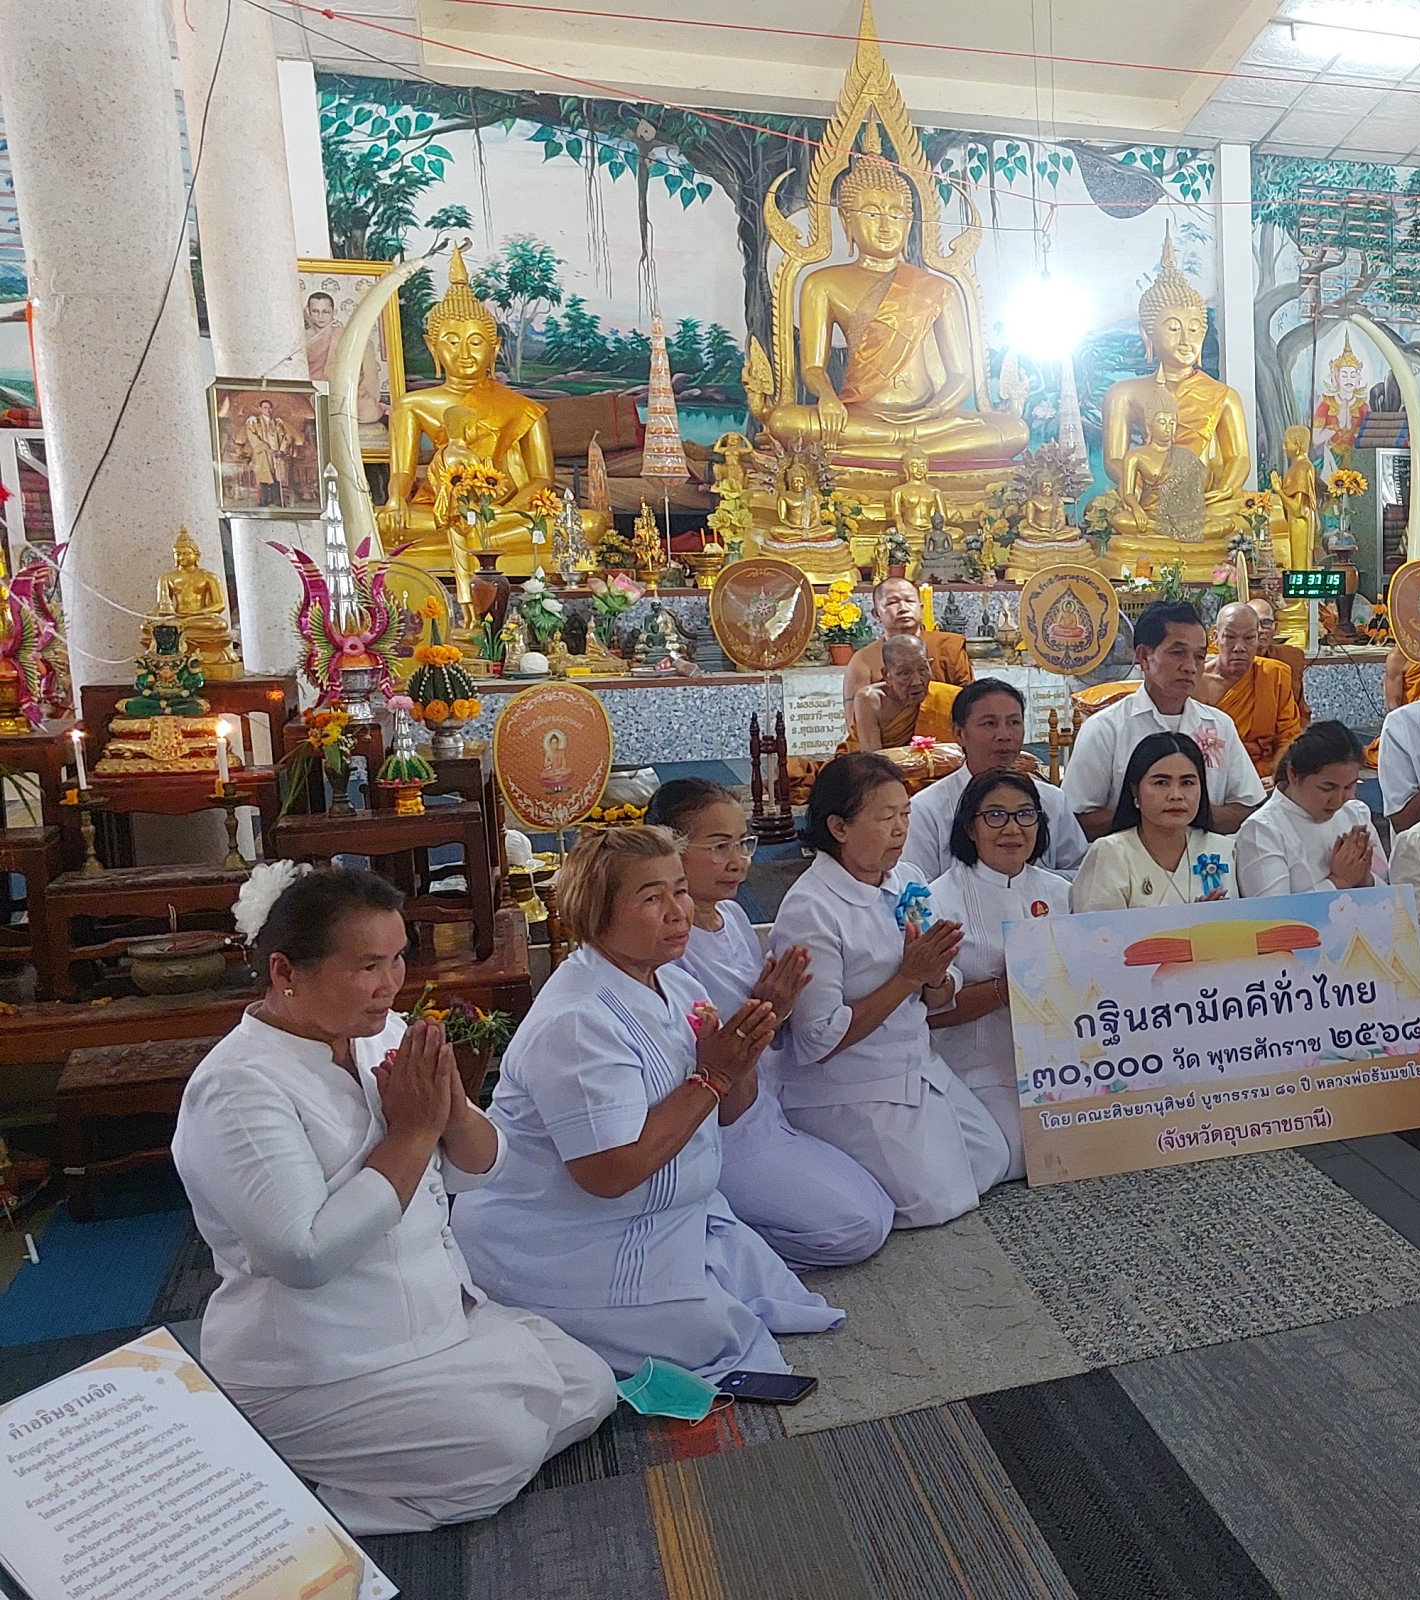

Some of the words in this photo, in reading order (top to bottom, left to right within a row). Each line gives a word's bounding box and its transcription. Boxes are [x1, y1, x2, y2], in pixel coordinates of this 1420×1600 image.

[1074, 970, 1377, 1045] กฐินสามัคคีทั่วไทย
[1032, 1052, 1163, 1089] ๓๐,๐๐๐
[1172, 1047, 1200, 1070] วัด
[1206, 1034, 1321, 1075] พุทธศักราช
[1041, 1111, 1071, 1130] โดย
[1077, 1089, 1195, 1124] คณะศิษยานุศิษย์
[1200, 1084, 1271, 1113] บูชาธรรม
[1275, 1081, 1296, 1097] ๘๑
[1301, 1075, 1311, 1093] ปี
[1156, 1108, 1333, 1153] (จังหวัดอุบลราชธานี)
